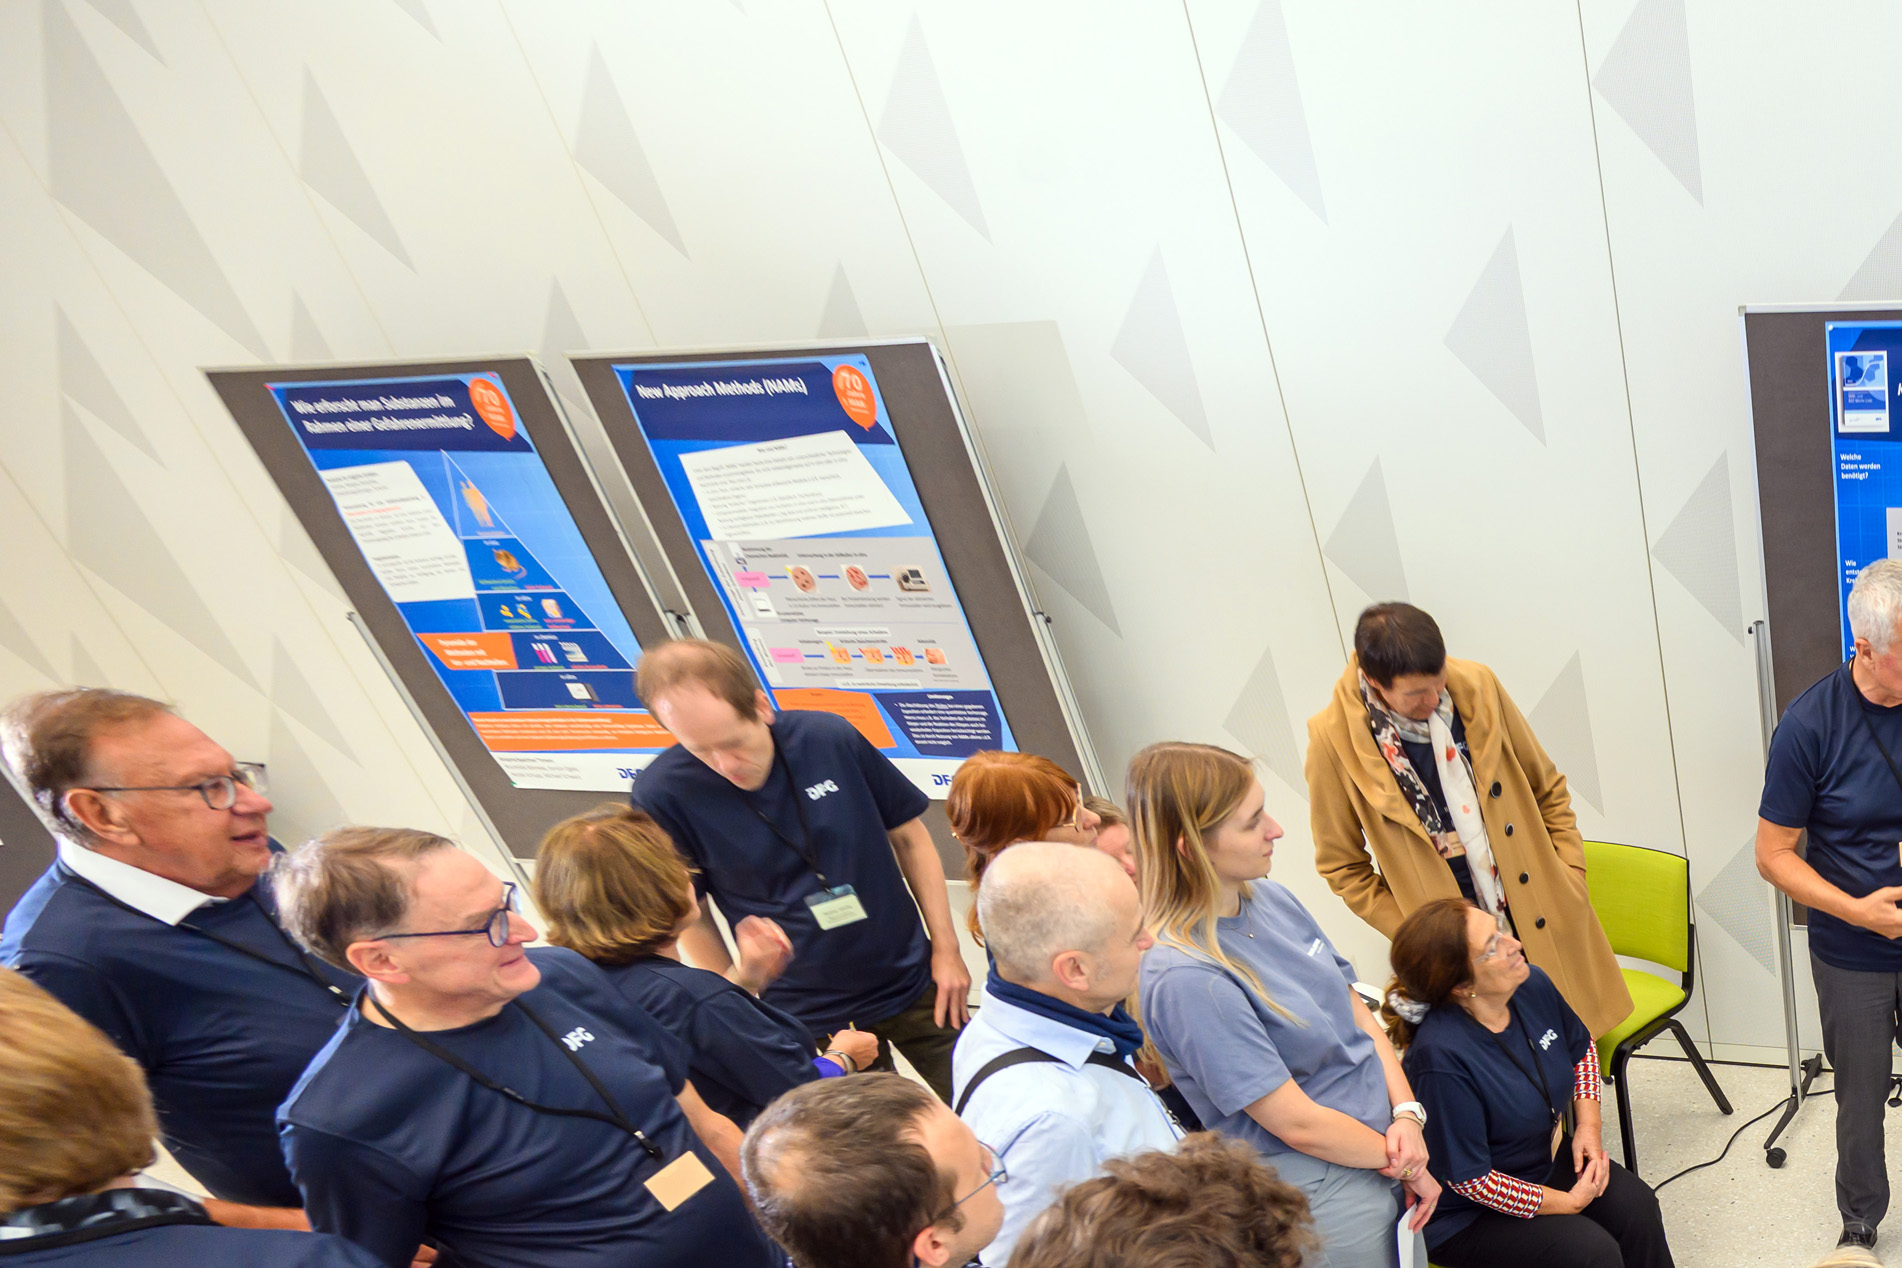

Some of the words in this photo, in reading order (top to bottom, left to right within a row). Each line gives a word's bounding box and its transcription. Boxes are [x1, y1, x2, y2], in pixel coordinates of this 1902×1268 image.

[635, 384, 665, 400] New
[663, 381, 715, 401] Approach
[715, 379, 765, 397] Methods
[763, 377, 808, 396] (NAMs)
[840, 372, 862, 391] 70
[1840, 453, 1861, 461] Welche
[1841, 472, 1868, 480] benötigt?
[932, 774, 954, 785] DF
[805, 779, 839, 801] DFG
[1539, 1029, 1558, 1050] DFG
